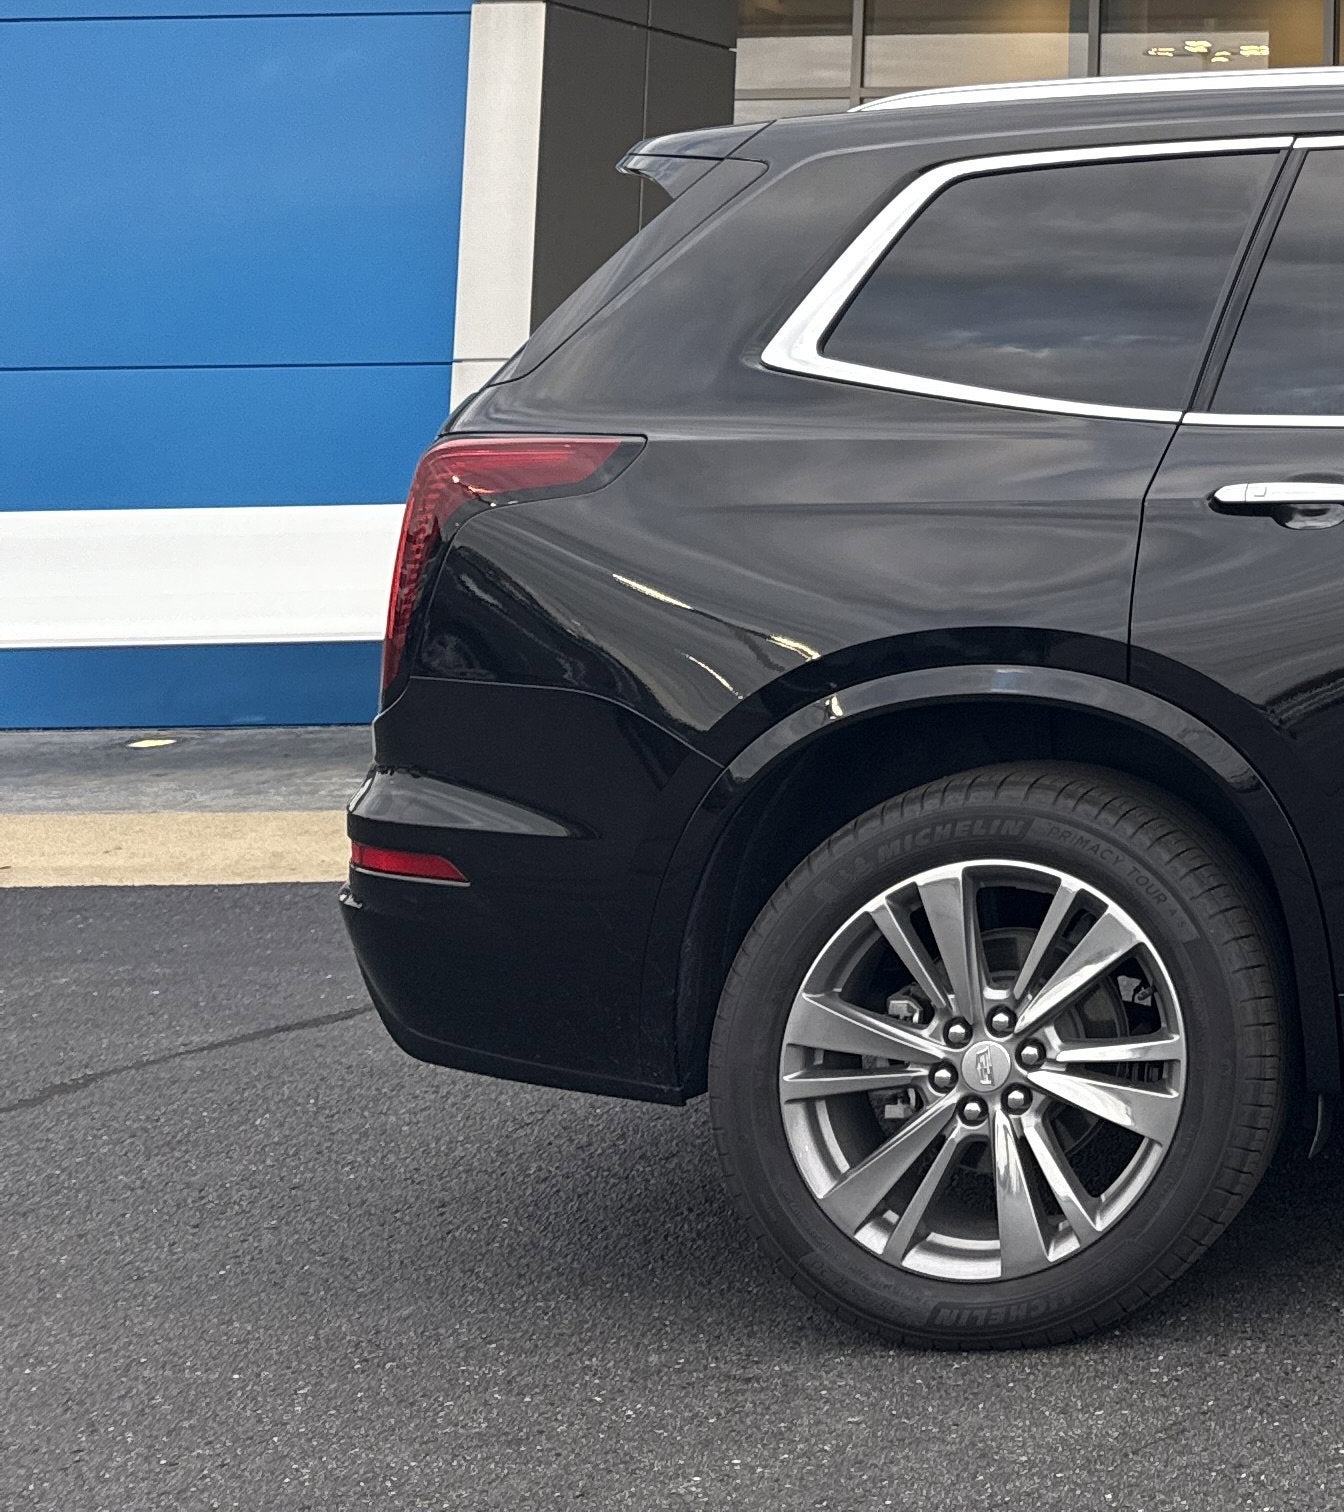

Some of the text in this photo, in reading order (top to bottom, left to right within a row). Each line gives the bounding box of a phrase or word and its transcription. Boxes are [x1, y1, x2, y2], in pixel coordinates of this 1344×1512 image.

[877, 819, 1024, 862] MICHELIN
[1048, 825, 1122, 866] PRIMACY
[1126, 865, 1168, 905] TOUR
